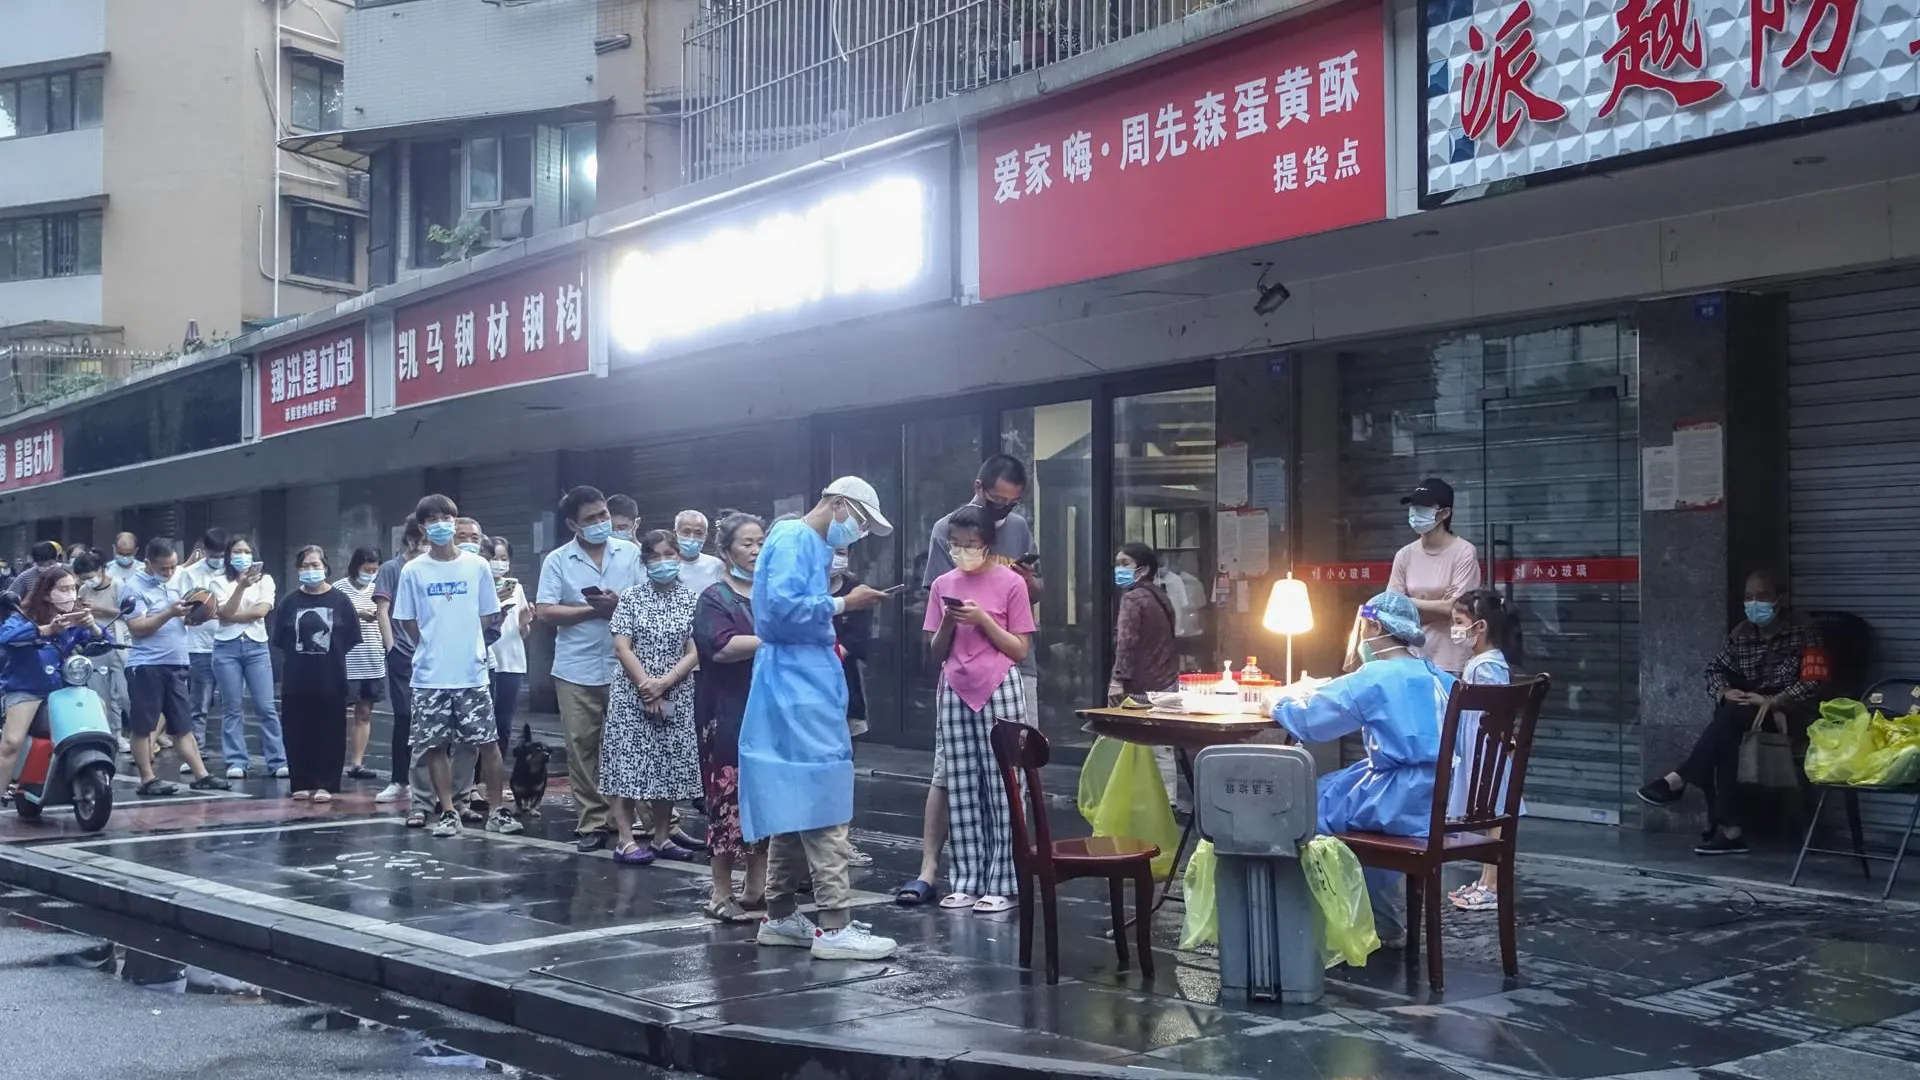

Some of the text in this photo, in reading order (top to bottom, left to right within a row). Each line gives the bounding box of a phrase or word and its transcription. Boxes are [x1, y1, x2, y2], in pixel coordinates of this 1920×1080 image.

[1460, 0, 1920, 149] 派越防
[993, 49, 1360, 205] 爱家嗨·周先森蛋黄酥
[1273, 137, 1361, 194] 提货点
[398, 284, 583, 382] 凯马钢材钢构
[1327, 567, 1370, 580] 小心玻璃
[1532, 563, 1588, 578] 小心玻璃
